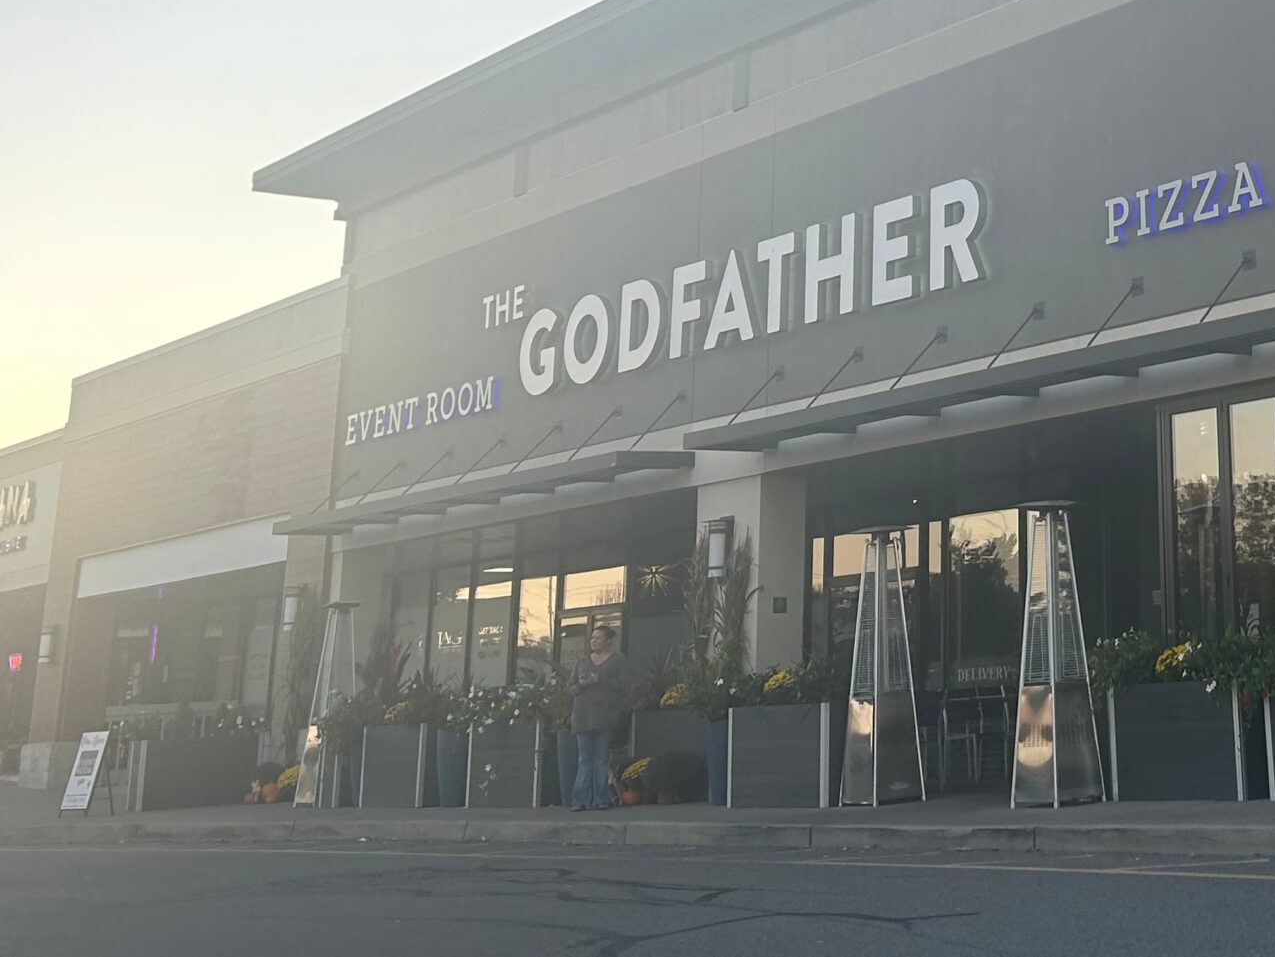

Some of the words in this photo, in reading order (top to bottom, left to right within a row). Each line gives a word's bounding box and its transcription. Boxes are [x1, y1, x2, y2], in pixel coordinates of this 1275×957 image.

[1104, 161, 1263, 245] PIZZA
[483, 284, 525, 329] THE
[519, 178, 982, 396] GODFATHER
[345, 396, 419, 446] EVENT
[425, 376, 494, 426] ROOM
[957, 666, 1010, 683] DELIVERY
